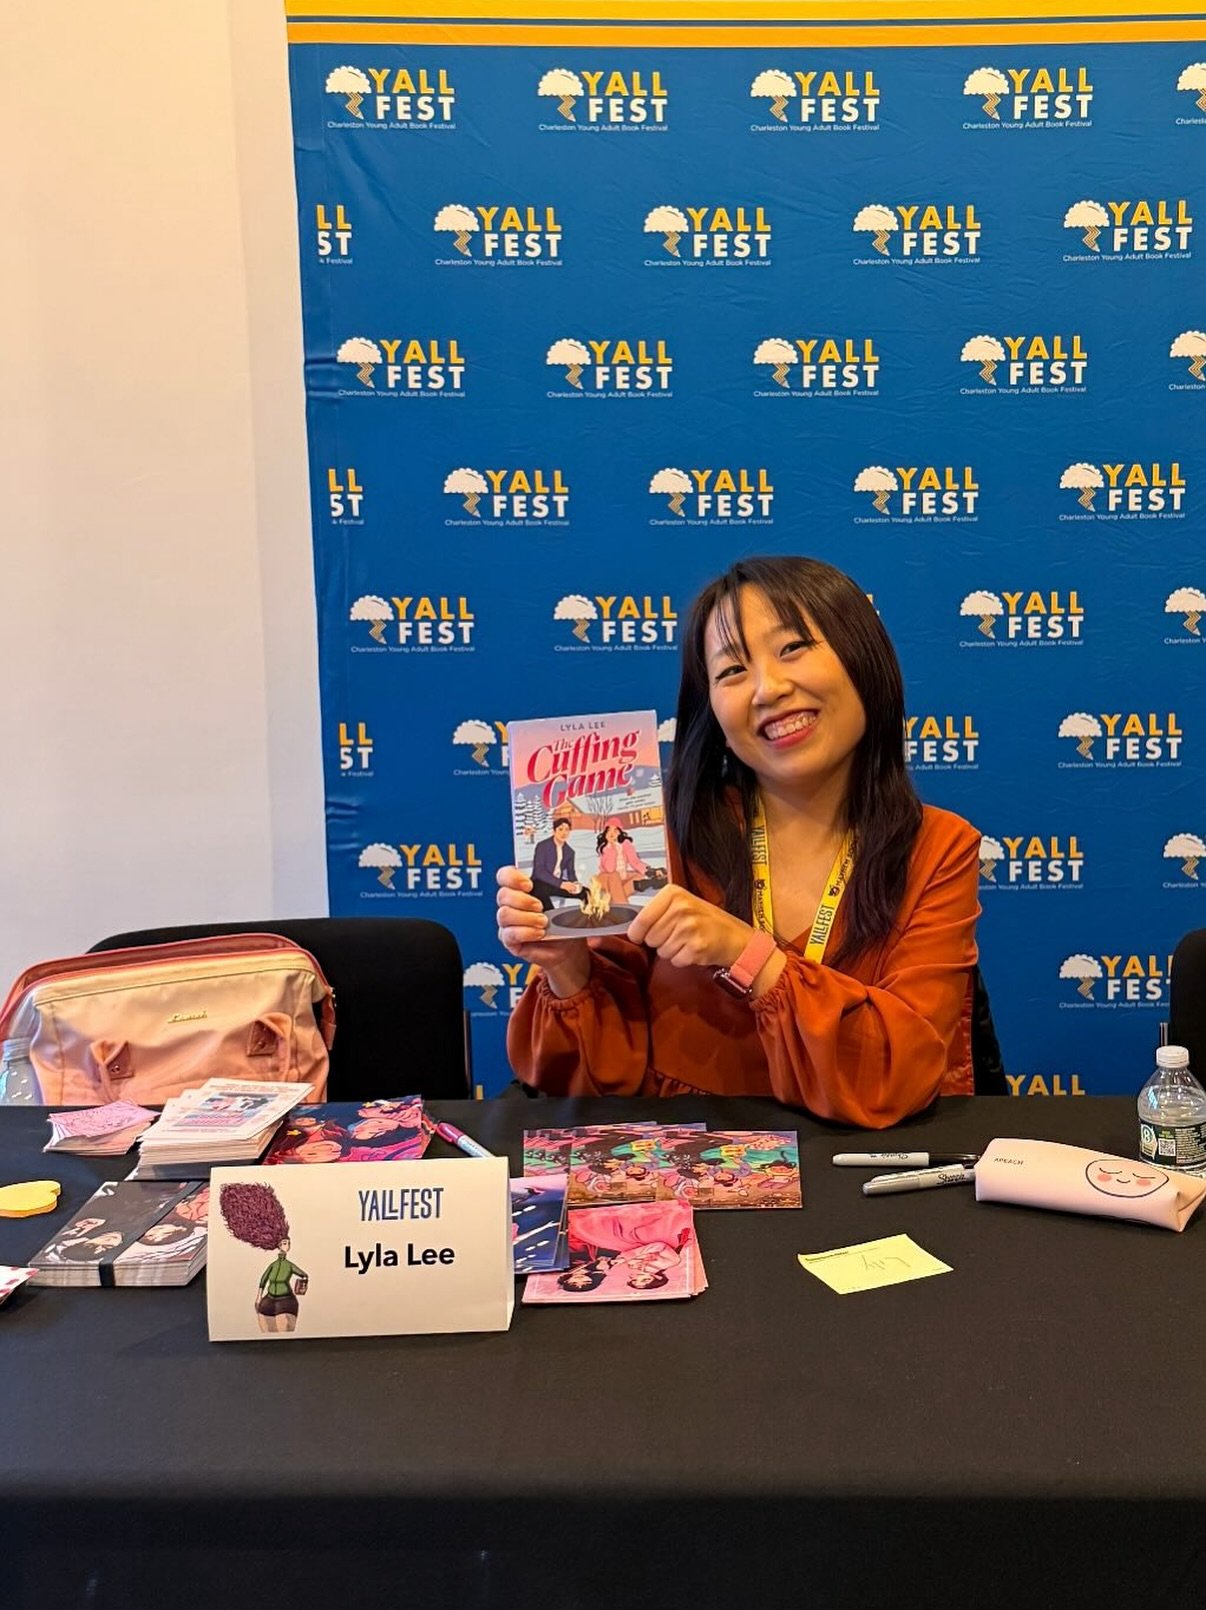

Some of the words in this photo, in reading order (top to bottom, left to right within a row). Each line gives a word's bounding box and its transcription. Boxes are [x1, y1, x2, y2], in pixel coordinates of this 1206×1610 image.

[368, 68, 454, 95] YALL
[581, 71, 667, 96] YALL
[794, 72, 880, 96] YALL
[1008, 68, 1093, 93] YALL
[376, 95, 454, 121] FEST
[588, 98, 667, 123] FEST
[801, 98, 880, 122] FEST
[1013, 94, 1092, 119] FEST
[366, 122, 387, 130] Young
[476, 206, 561, 232] YALL
[687, 208, 771, 232] YALL
[897, 205, 980, 230] YALL
[1108, 200, 1192, 226] YALL
[484, 233, 561, 258] FEST
[693, 234, 771, 258] FEST
[903, 231, 980, 256] FEST
[1113, 226, 1192, 251] FEST
[380, 339, 464, 364] YALL
[588, 341, 672, 364] YALL
[796, 339, 879, 363] YALL
[1004, 336, 1087, 360] YALL
[387, 365, 465, 389] FEST
[595, 366, 672, 389] FEST
[802, 365, 879, 388] FEST
[1010, 361, 1087, 385] FEST
[486, 470, 568, 493] YALL
[691, 470, 773, 492] YALL
[896, 467, 978, 490] YALL
[1103, 463, 1185, 487] YALL
[493, 495, 568, 518] FEST
[698, 494, 773, 517] FEST
[902, 492, 978, 514] FEST
[1108, 488, 1185, 511] FEST
[391, 597, 474, 620] YALL
[595, 596, 677, 619] YALL
[1002, 591, 1083, 614] YALL
[398, 622, 474, 644] FEST
[602, 620, 677, 643] FEST
[1008, 616, 1083, 638] FEST
[588, 722, 606, 730] LEE
[1100, 714, 1182, 736] YALL
[553, 738, 574, 752] The
[1106, 737, 1182, 759] FEST
[527, 730, 640, 784] Cuffing
[542, 764, 634, 811] Game
[400, 844, 481, 866] YALL
[1002, 837, 1083, 859] YALL
[407, 868, 482, 889] FEST
[1009, 860, 1083, 882] FEST
[810, 904, 836, 945] YALLFEST
[1107, 978, 1170, 1000] FES
[1006, 1074, 1085, 1096] YALL
[994, 1157, 1025, 1166] APEACH
[358, 1187, 444, 1221] YALLFEST
[345, 1242, 398, 1274] Lyla
[408, 1243, 455, 1266] Lee
